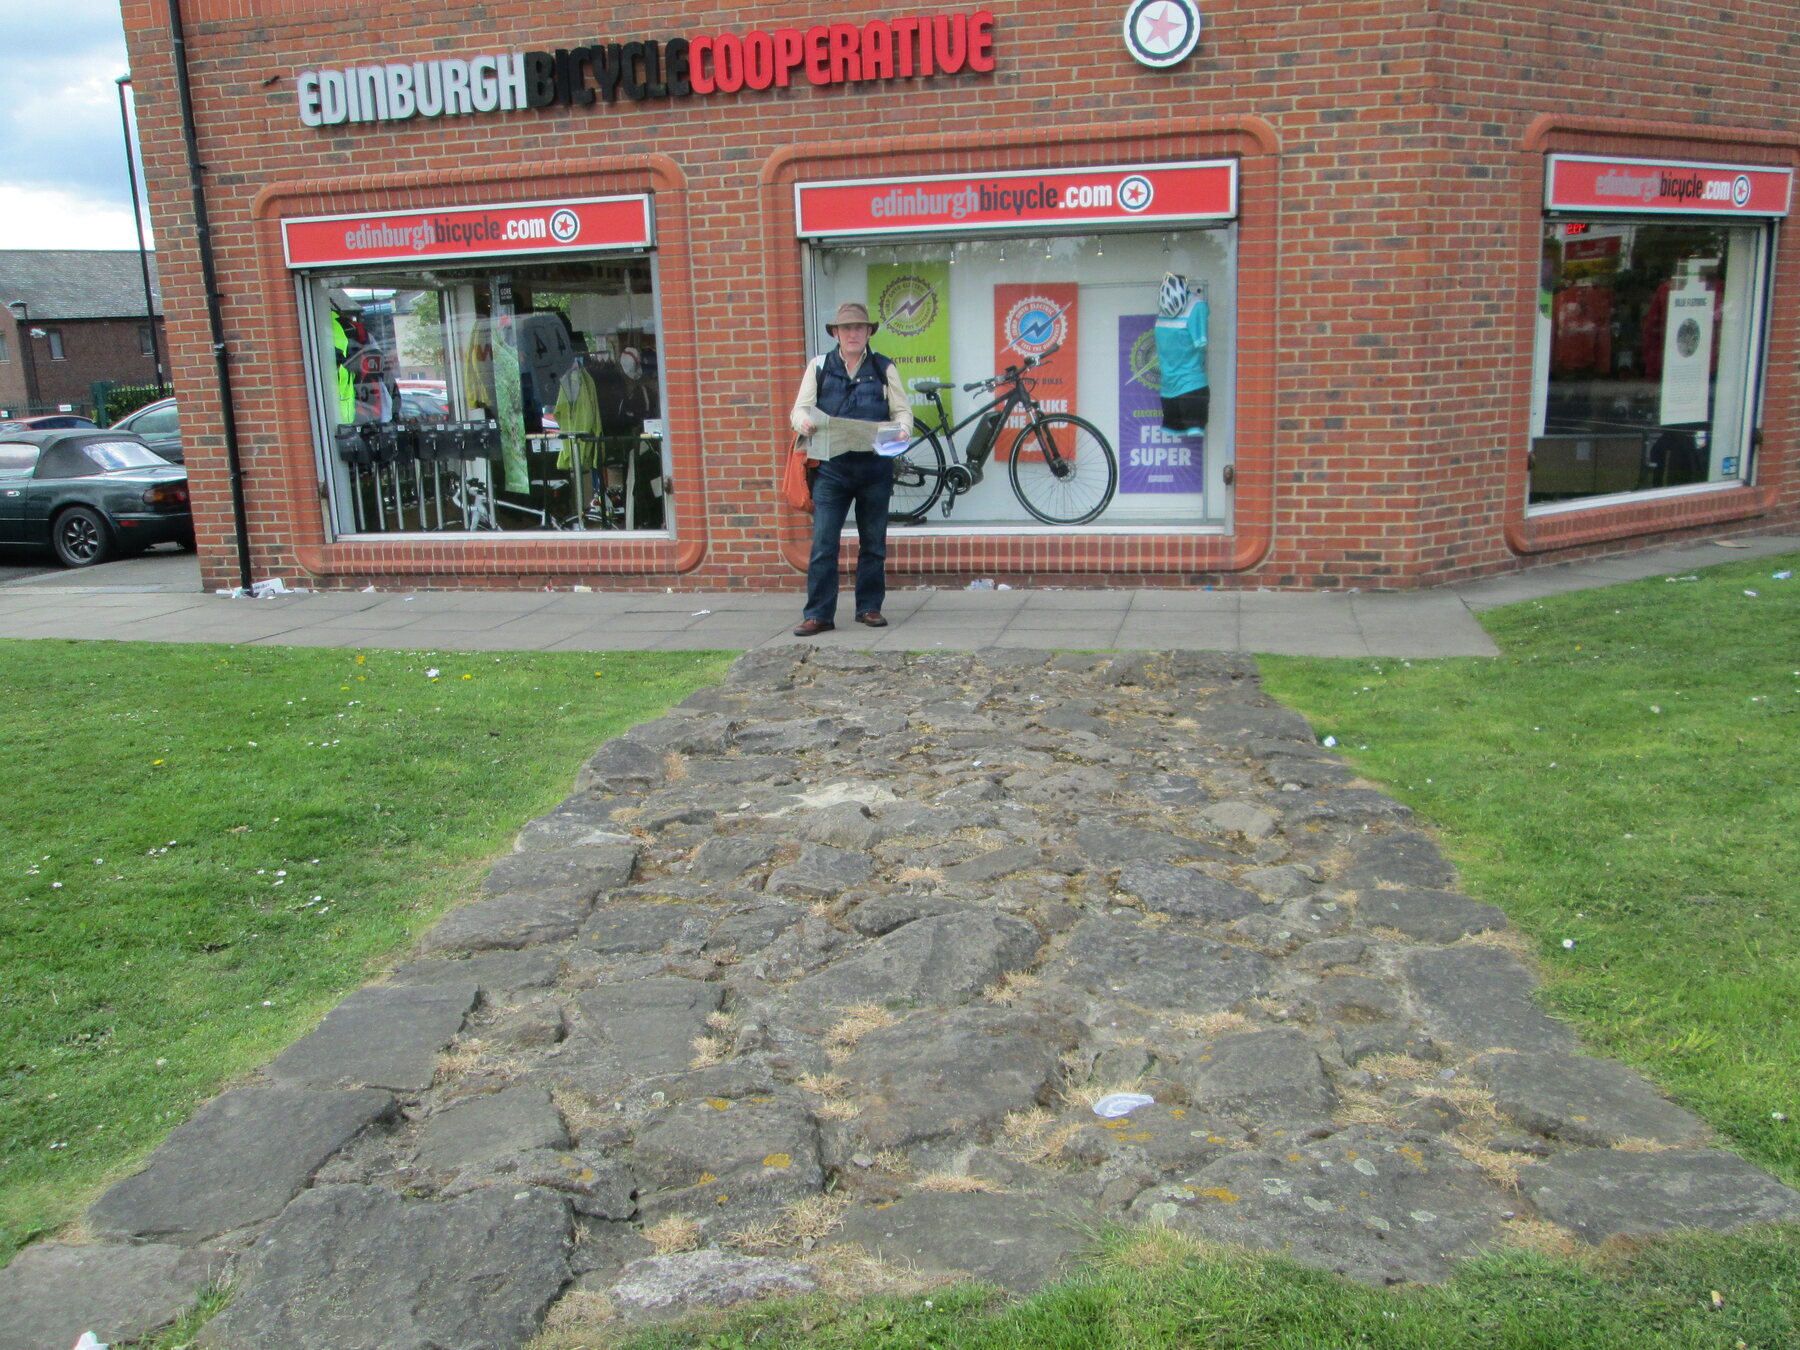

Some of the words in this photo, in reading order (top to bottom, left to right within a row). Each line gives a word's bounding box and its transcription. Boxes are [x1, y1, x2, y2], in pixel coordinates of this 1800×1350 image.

[915, 355, 937, 364] BIKES
[1040, 400, 1068, 413] LIKE
[1129, 447, 1192, 467] SUPER
